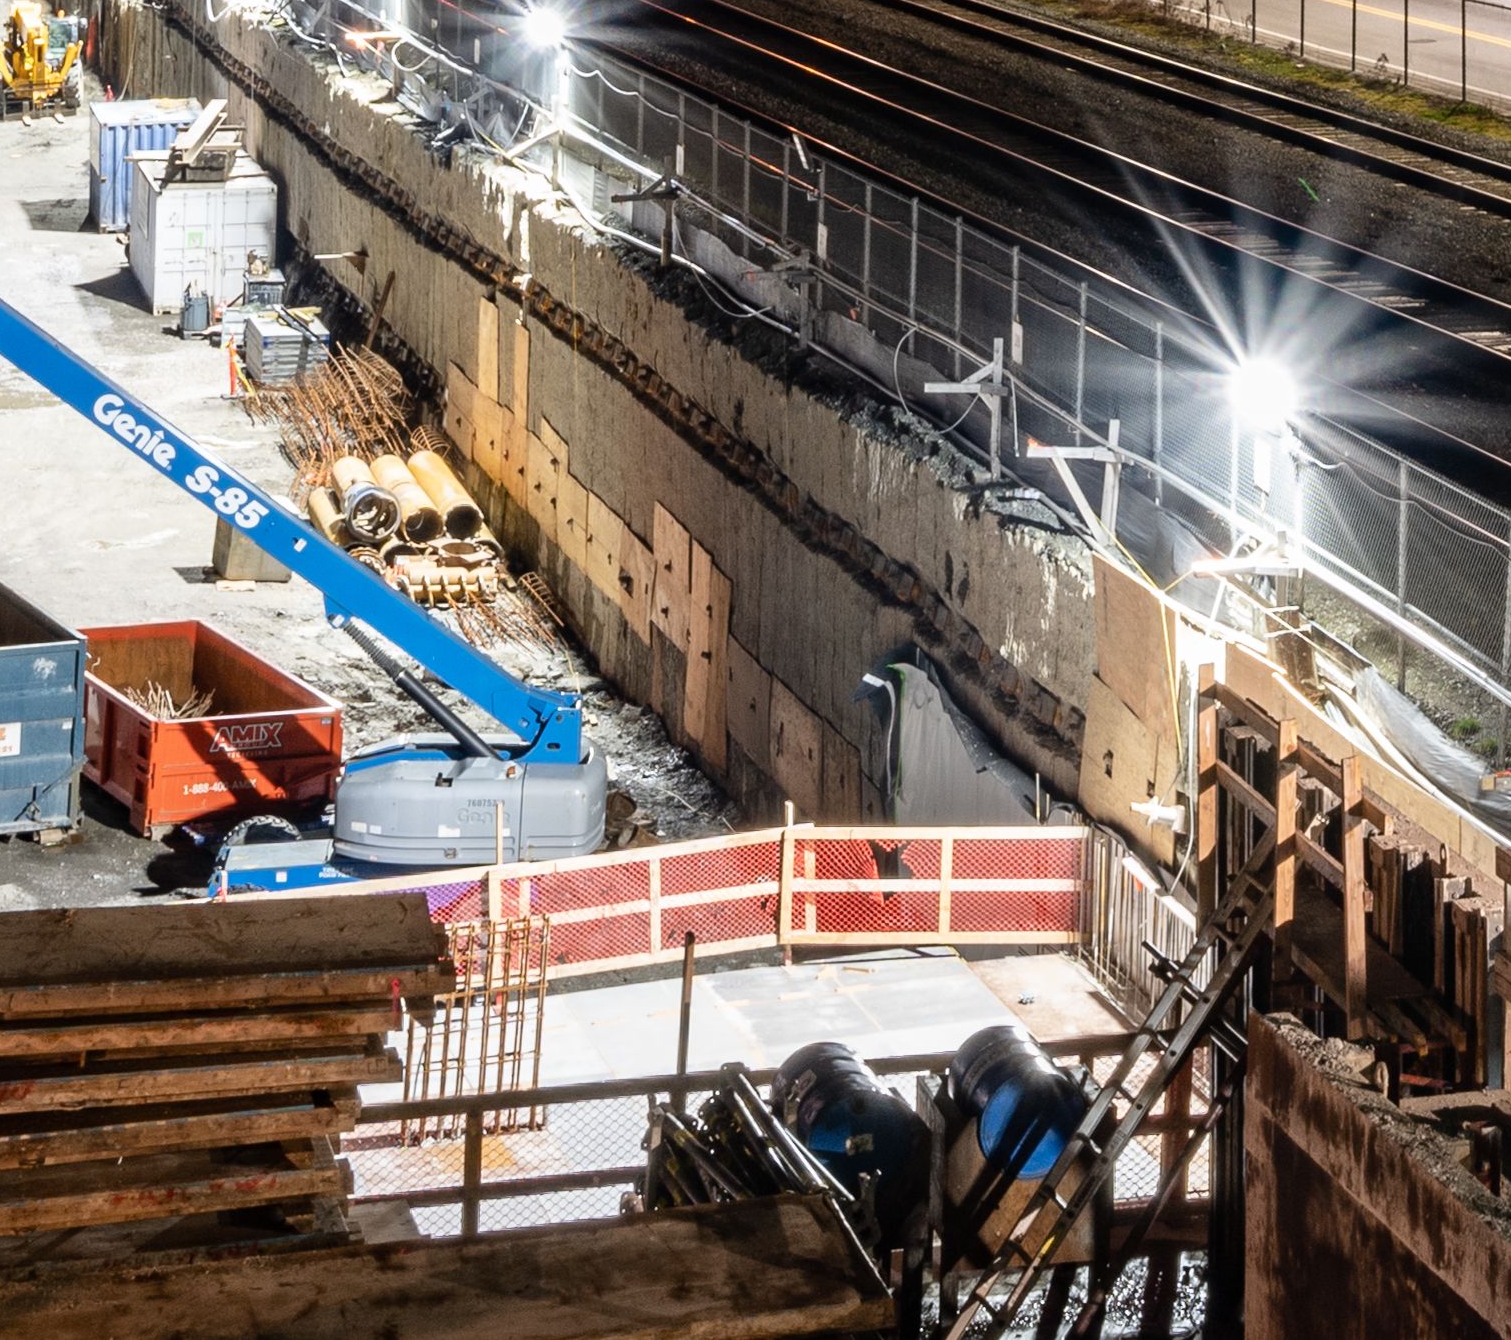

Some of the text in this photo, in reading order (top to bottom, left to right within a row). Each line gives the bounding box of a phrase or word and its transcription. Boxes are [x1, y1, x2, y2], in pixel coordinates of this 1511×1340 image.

[93, 394, 176, 468] Genie
[185, 465, 270, 529] S-85
[209, 722, 283, 753] AMIX
[457, 808, 511, 824] Gene
